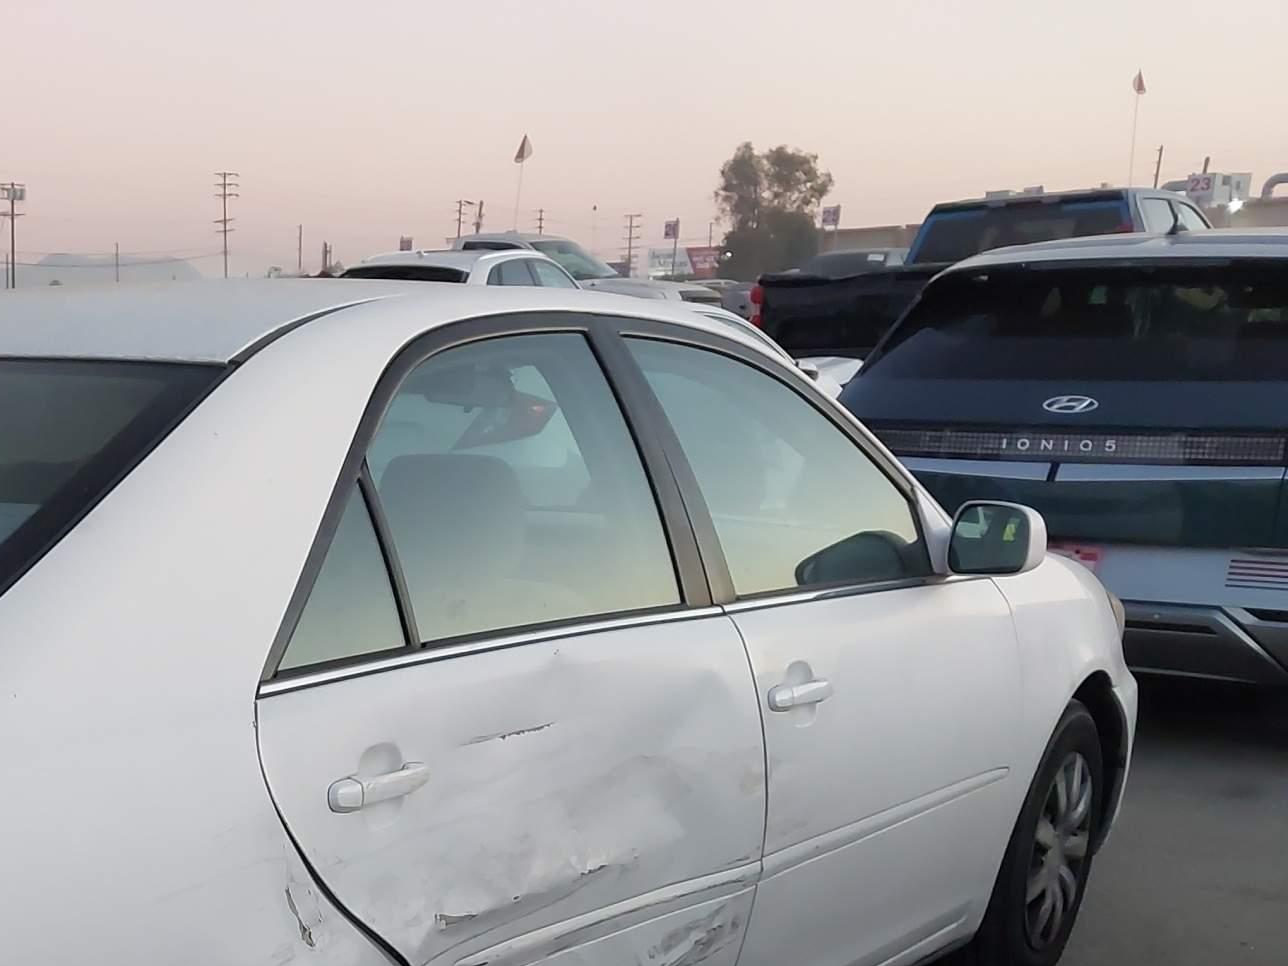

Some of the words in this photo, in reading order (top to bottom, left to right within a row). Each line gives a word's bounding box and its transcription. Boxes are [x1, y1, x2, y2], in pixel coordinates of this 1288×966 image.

[1189, 177, 1211, 192] 23
[1001, 438, 1092, 451] IONIQ
[1105, 439, 1116, 452] 5
